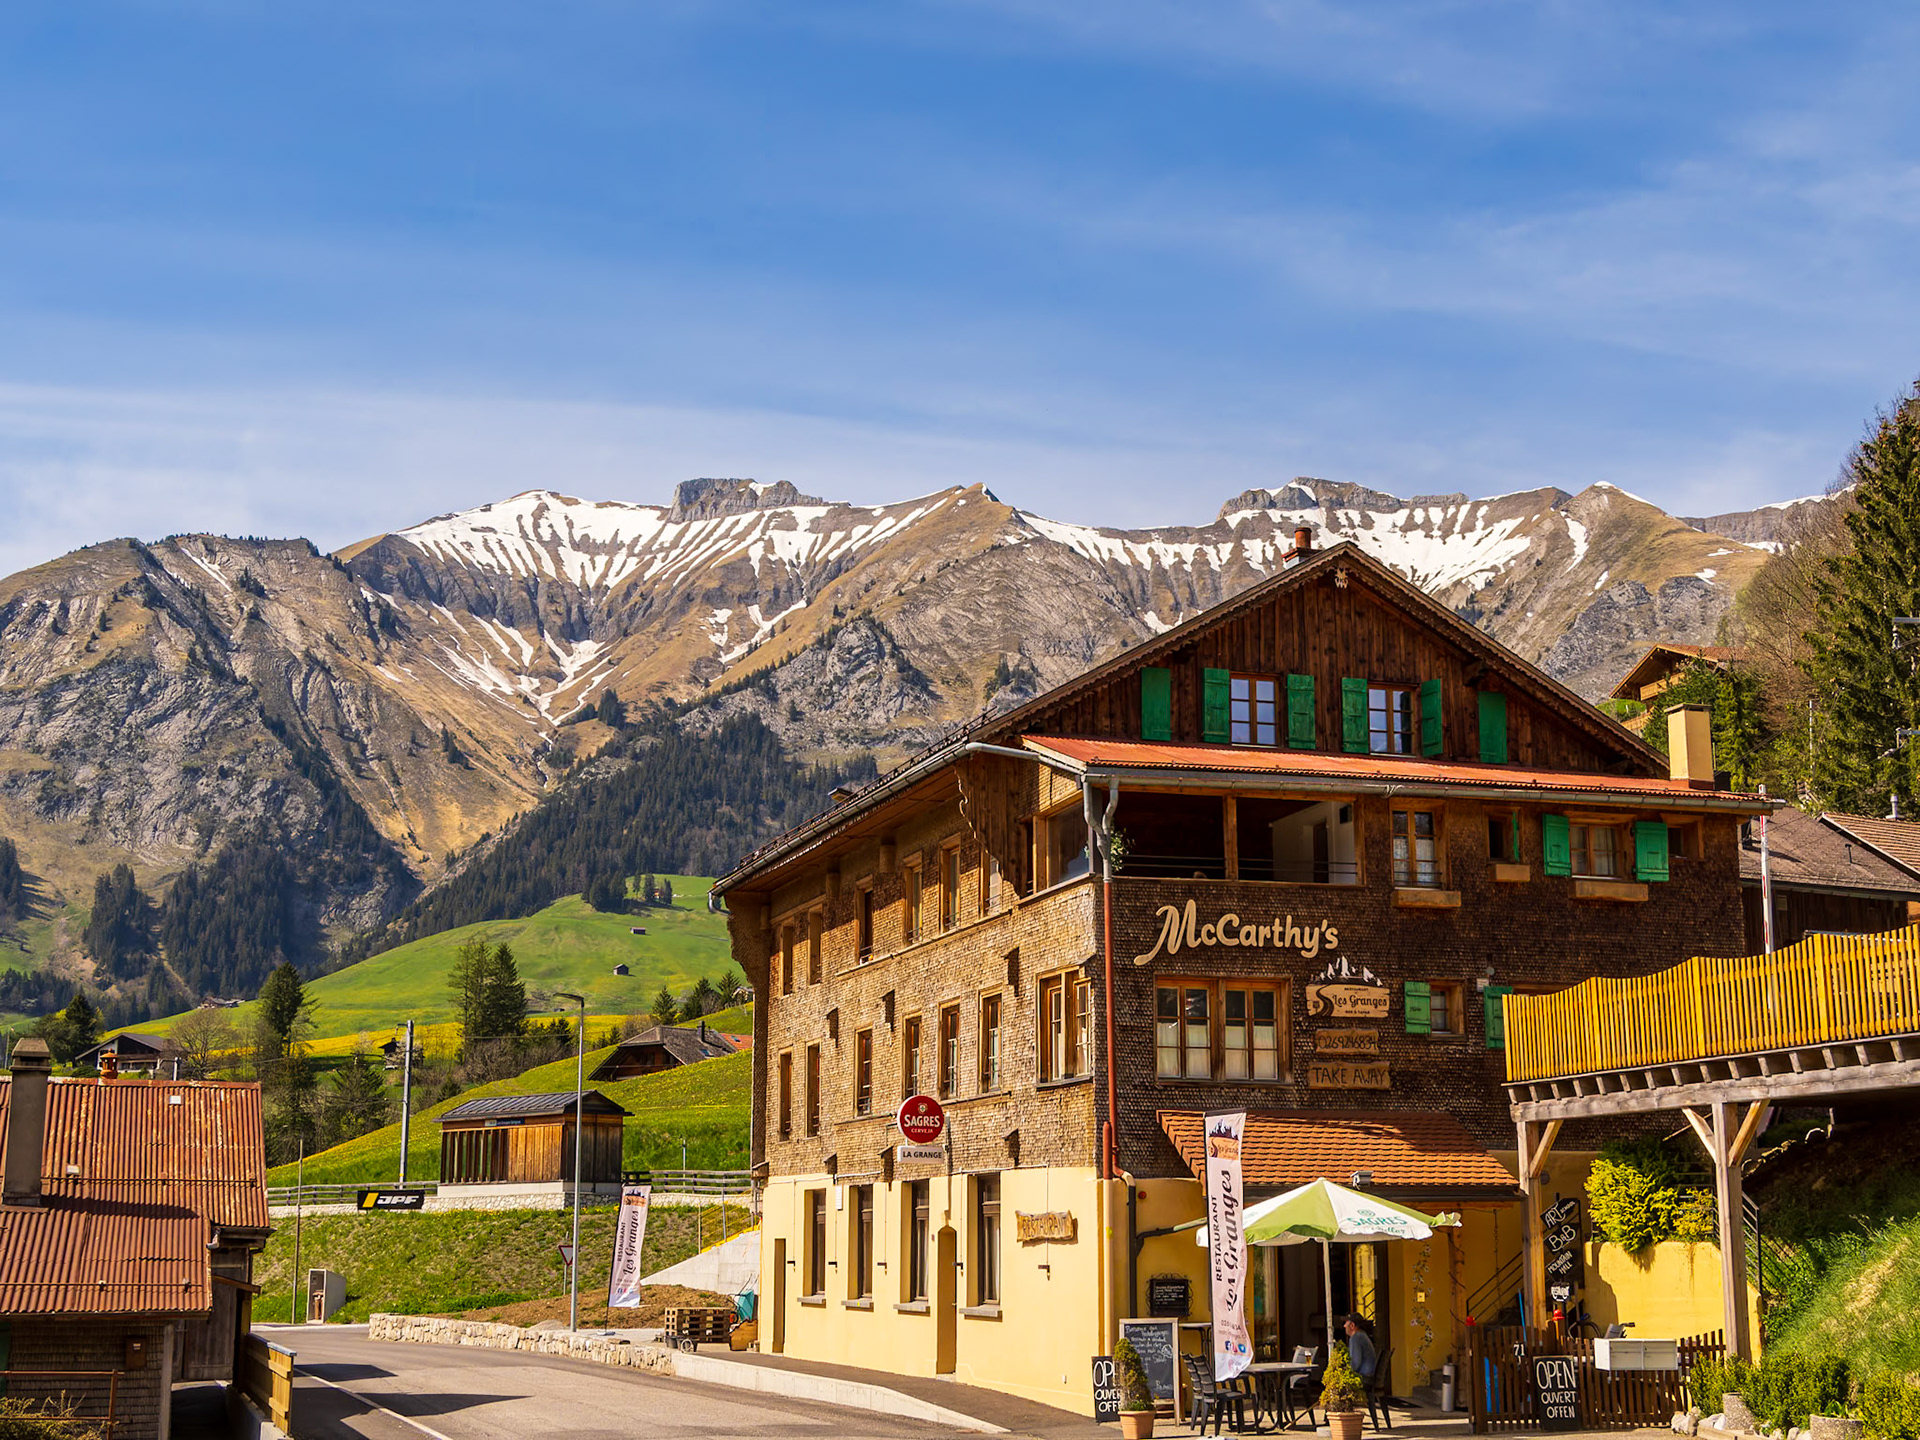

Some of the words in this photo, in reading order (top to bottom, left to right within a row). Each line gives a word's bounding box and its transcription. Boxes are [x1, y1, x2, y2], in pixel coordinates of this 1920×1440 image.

[1134, 899, 1338, 965] McCarthy's
[1332, 995, 1347, 1007] Les
[1349, 995, 1387, 1008] Granges
[1312, 1067, 1347, 1084] TAKE
[1353, 1068, 1386, 1085] AWAY
[904, 1114, 940, 1127] SAGRES
[377, 1195, 419, 1204] JPF
[1221, 1170, 1239, 1270] Granges
[1347, 1216, 1407, 1226] SAGRES
[1545, 1202, 1566, 1229] ART
[617, 1222, 626, 1261] RESTAURANT
[625, 1210, 639, 1257] Granges
[1211, 1195, 1222, 1281] RESTAURANT
[623, 1259, 636, 1275] Les
[1513, 1344, 1525, 1356] 71
[1536, 1361, 1577, 1389] OPEN
[1541, 1391, 1576, 1404] OUVERT
[1547, 1405, 1575, 1418] OFFEN
